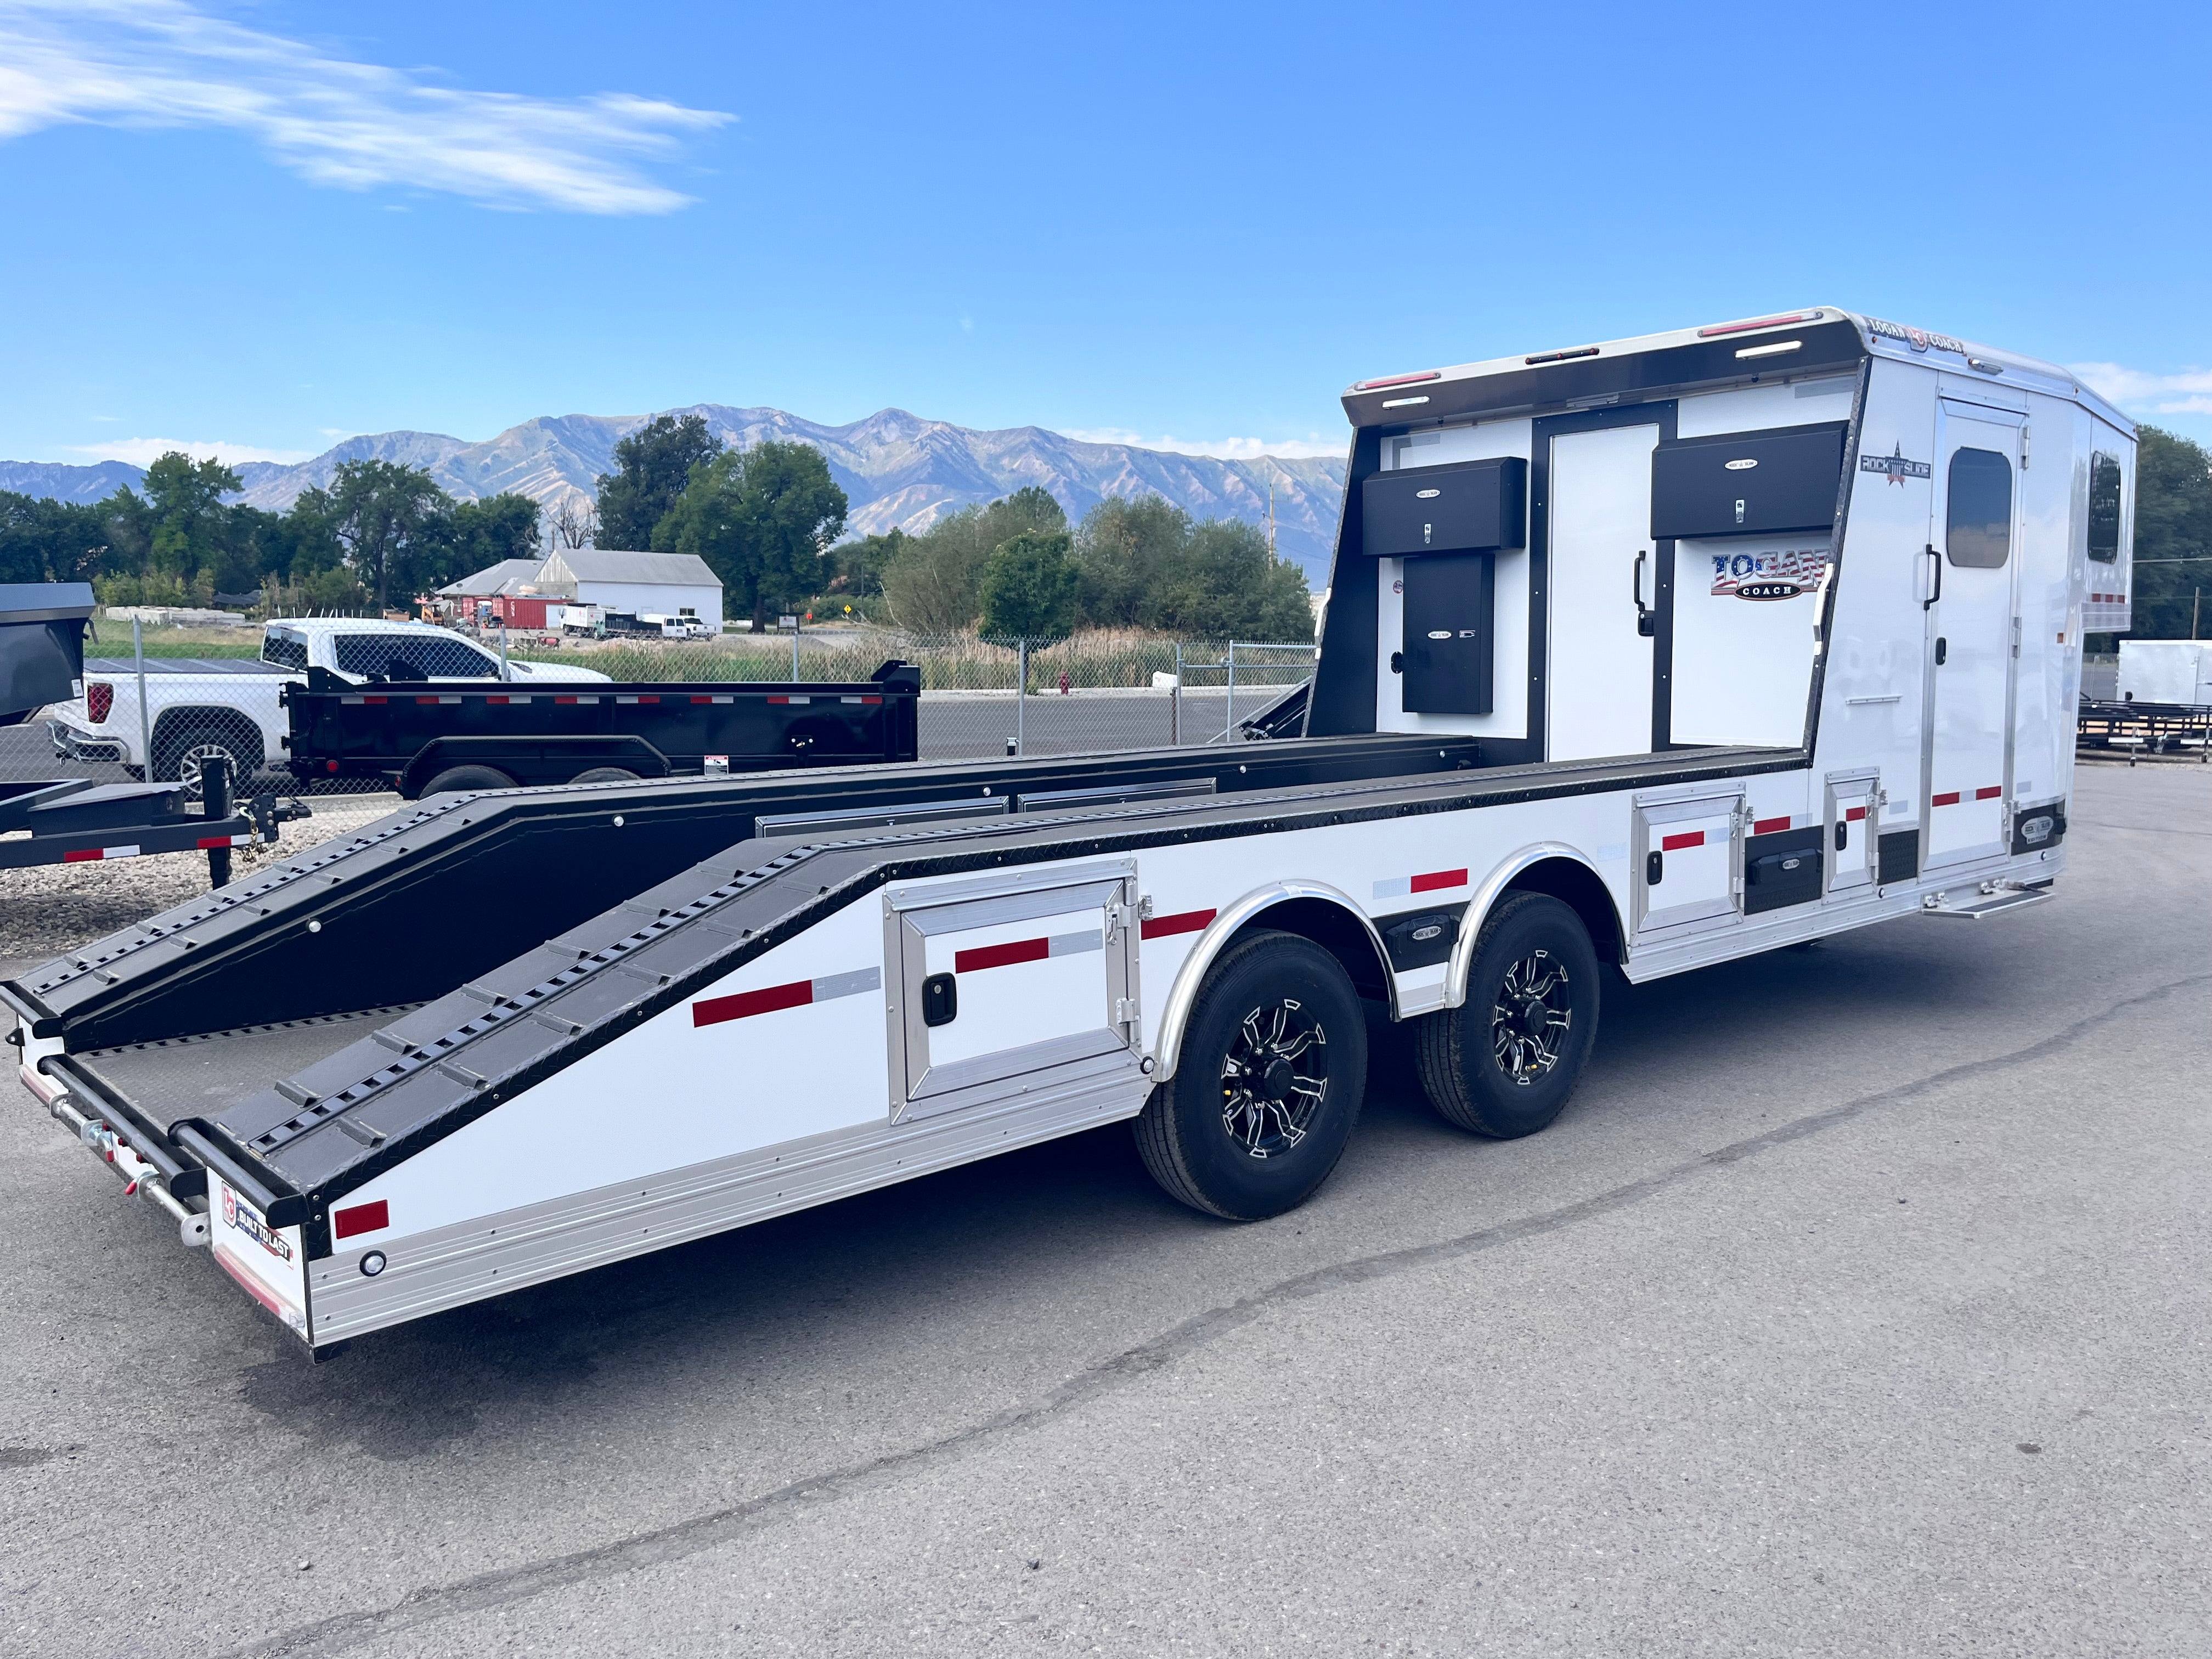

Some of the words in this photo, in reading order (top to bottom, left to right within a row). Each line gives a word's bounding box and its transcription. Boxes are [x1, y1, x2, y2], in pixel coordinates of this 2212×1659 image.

[1869, 319, 1905, 338] LOGAN
[1929, 334, 1962, 352] COACH
[1863, 456, 1891, 473] ROCK
[1711, 549, 1830, 589] LOGAN
[1742, 586, 1791, 595] COACH
[239, 1209, 258, 1234] BUILT
[258, 1227, 268, 1243] TO
[269, 1232, 289, 1258] LAST
